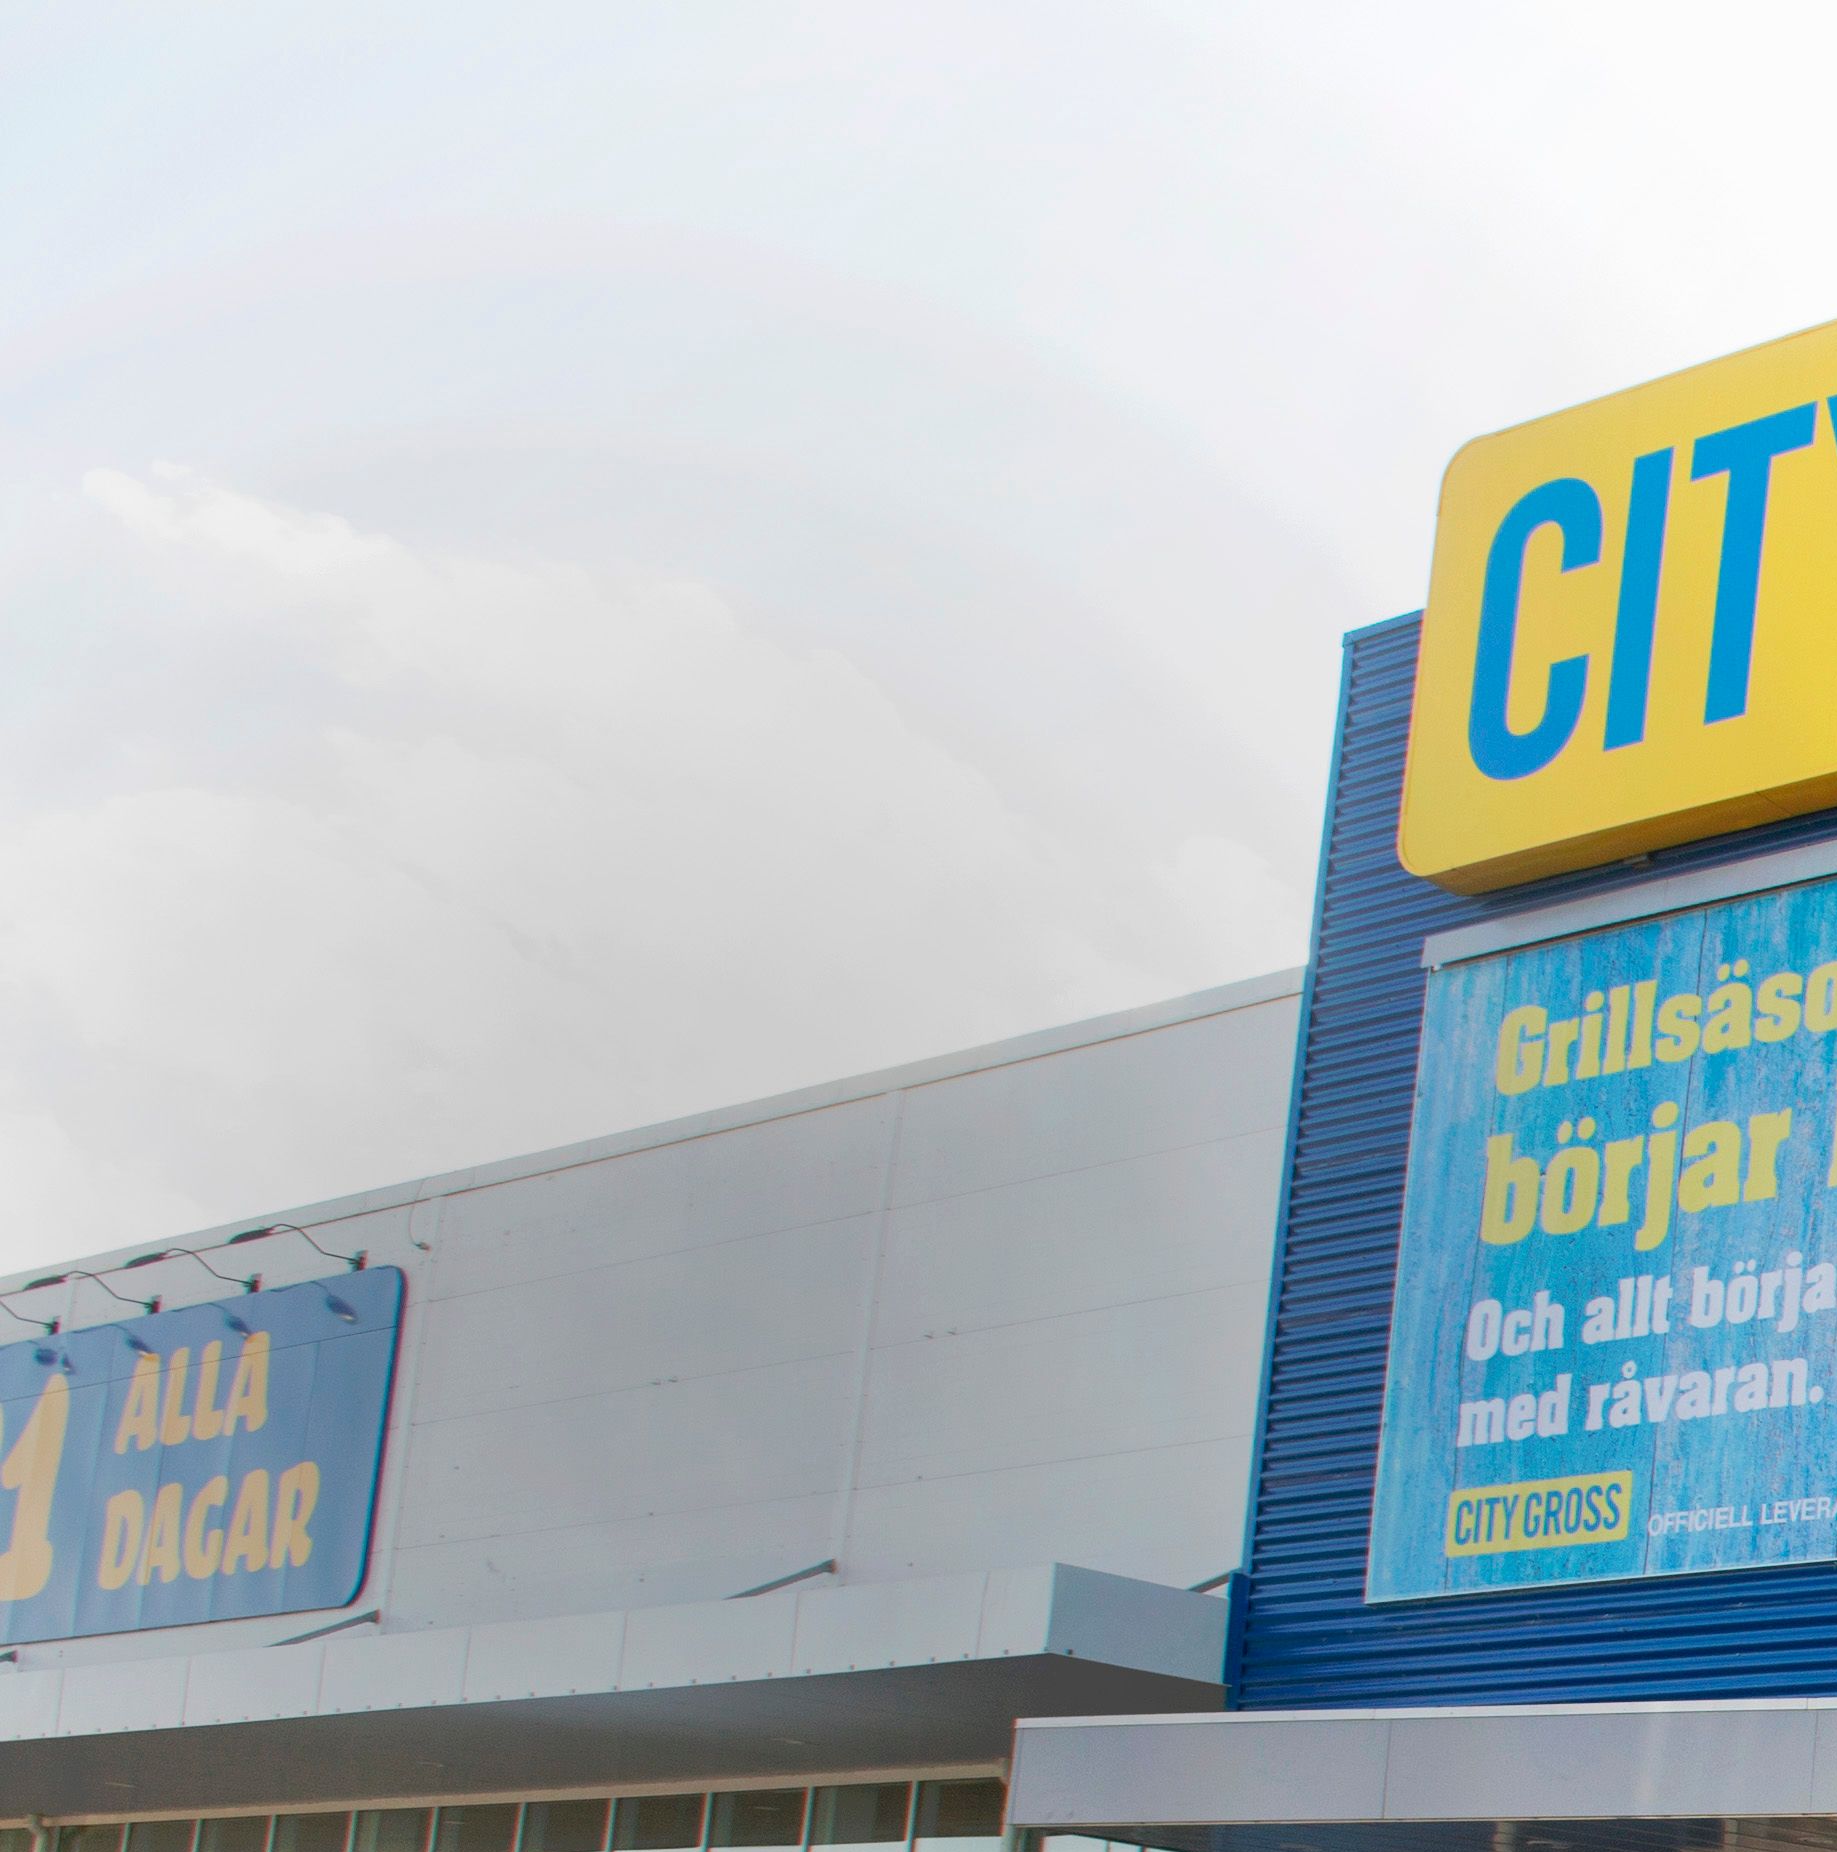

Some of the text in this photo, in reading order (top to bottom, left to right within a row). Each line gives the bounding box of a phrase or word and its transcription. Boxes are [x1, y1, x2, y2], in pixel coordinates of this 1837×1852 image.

[1480, 1100, 1793, 1252] börjar
[1466, 1290, 1565, 1361] Och
[1582, 1274, 1674, 1345] allt
[113, 1331, 271, 1455] ALLA
[1457, 1360, 1824, 1448] med råvaran.
[0, 1373, 70, 1601] 1
[98, 1461, 320, 1591] DAGAR
[1454, 1483, 1623, 1546] CITY GROSS
[1648, 1505, 1752, 1538] OFFICIELL
